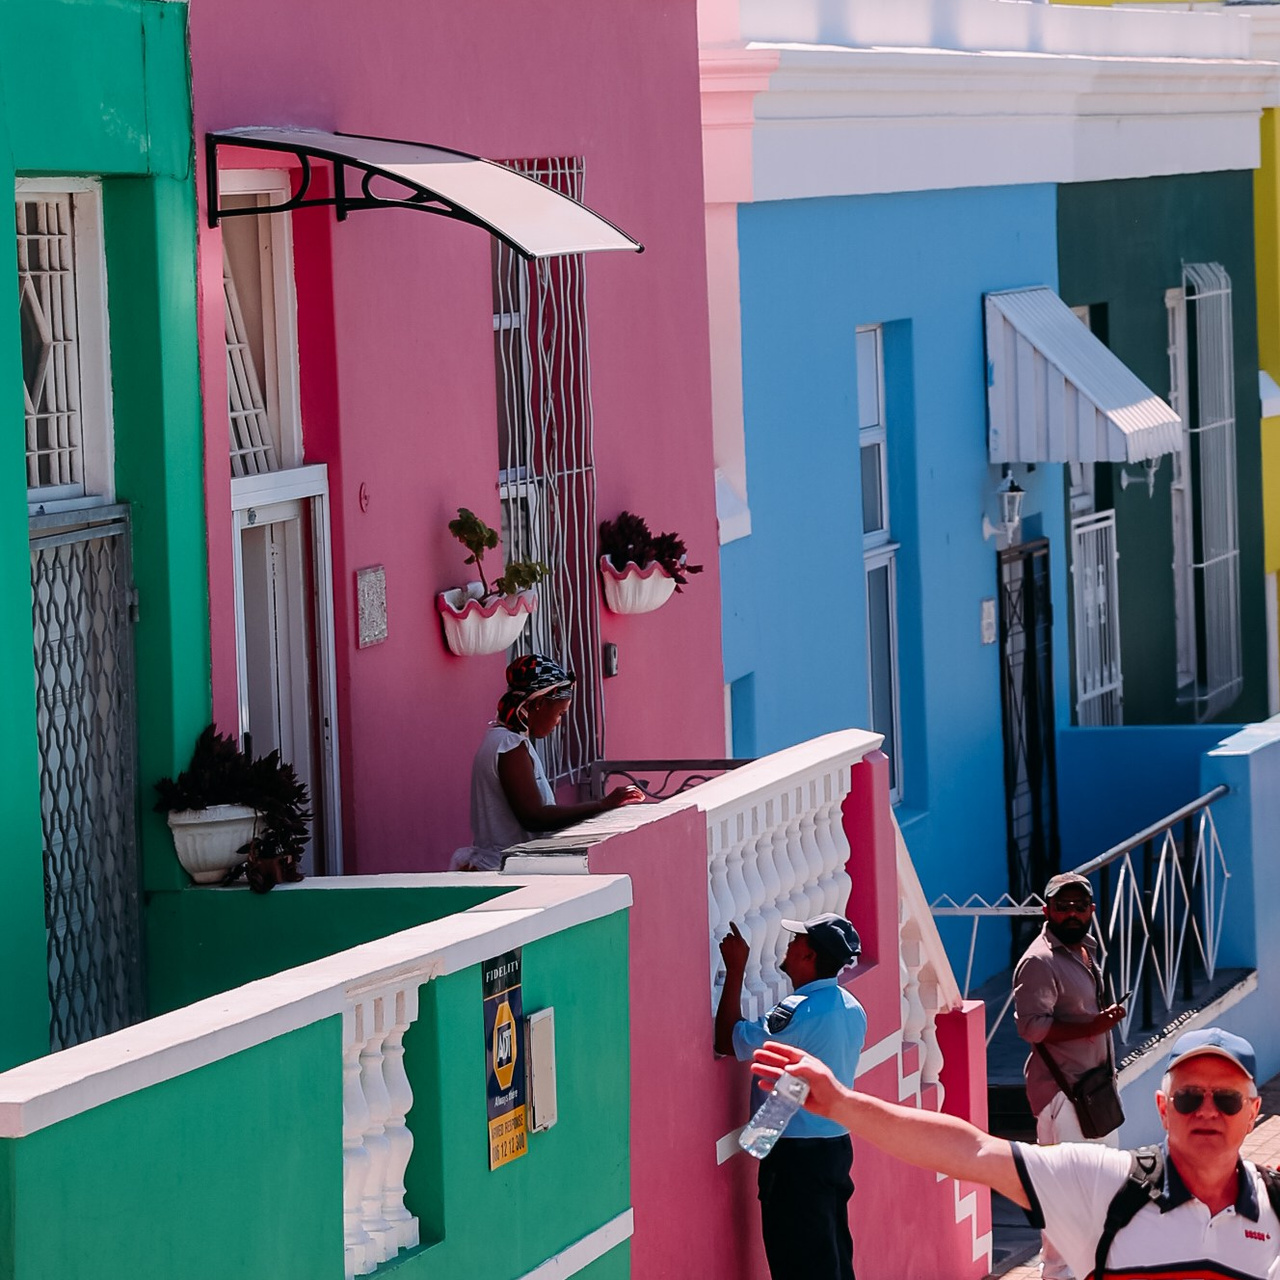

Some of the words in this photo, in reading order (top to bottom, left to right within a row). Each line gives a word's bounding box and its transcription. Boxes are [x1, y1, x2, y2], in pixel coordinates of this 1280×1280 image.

[486, 960, 519, 983] FIDELITY
[497, 1029, 512, 1062] ADT
[494, 1094, 508, 1108] Always
[501, 1140, 508, 1158] 12
[508, 1137, 515, 1154] 12
